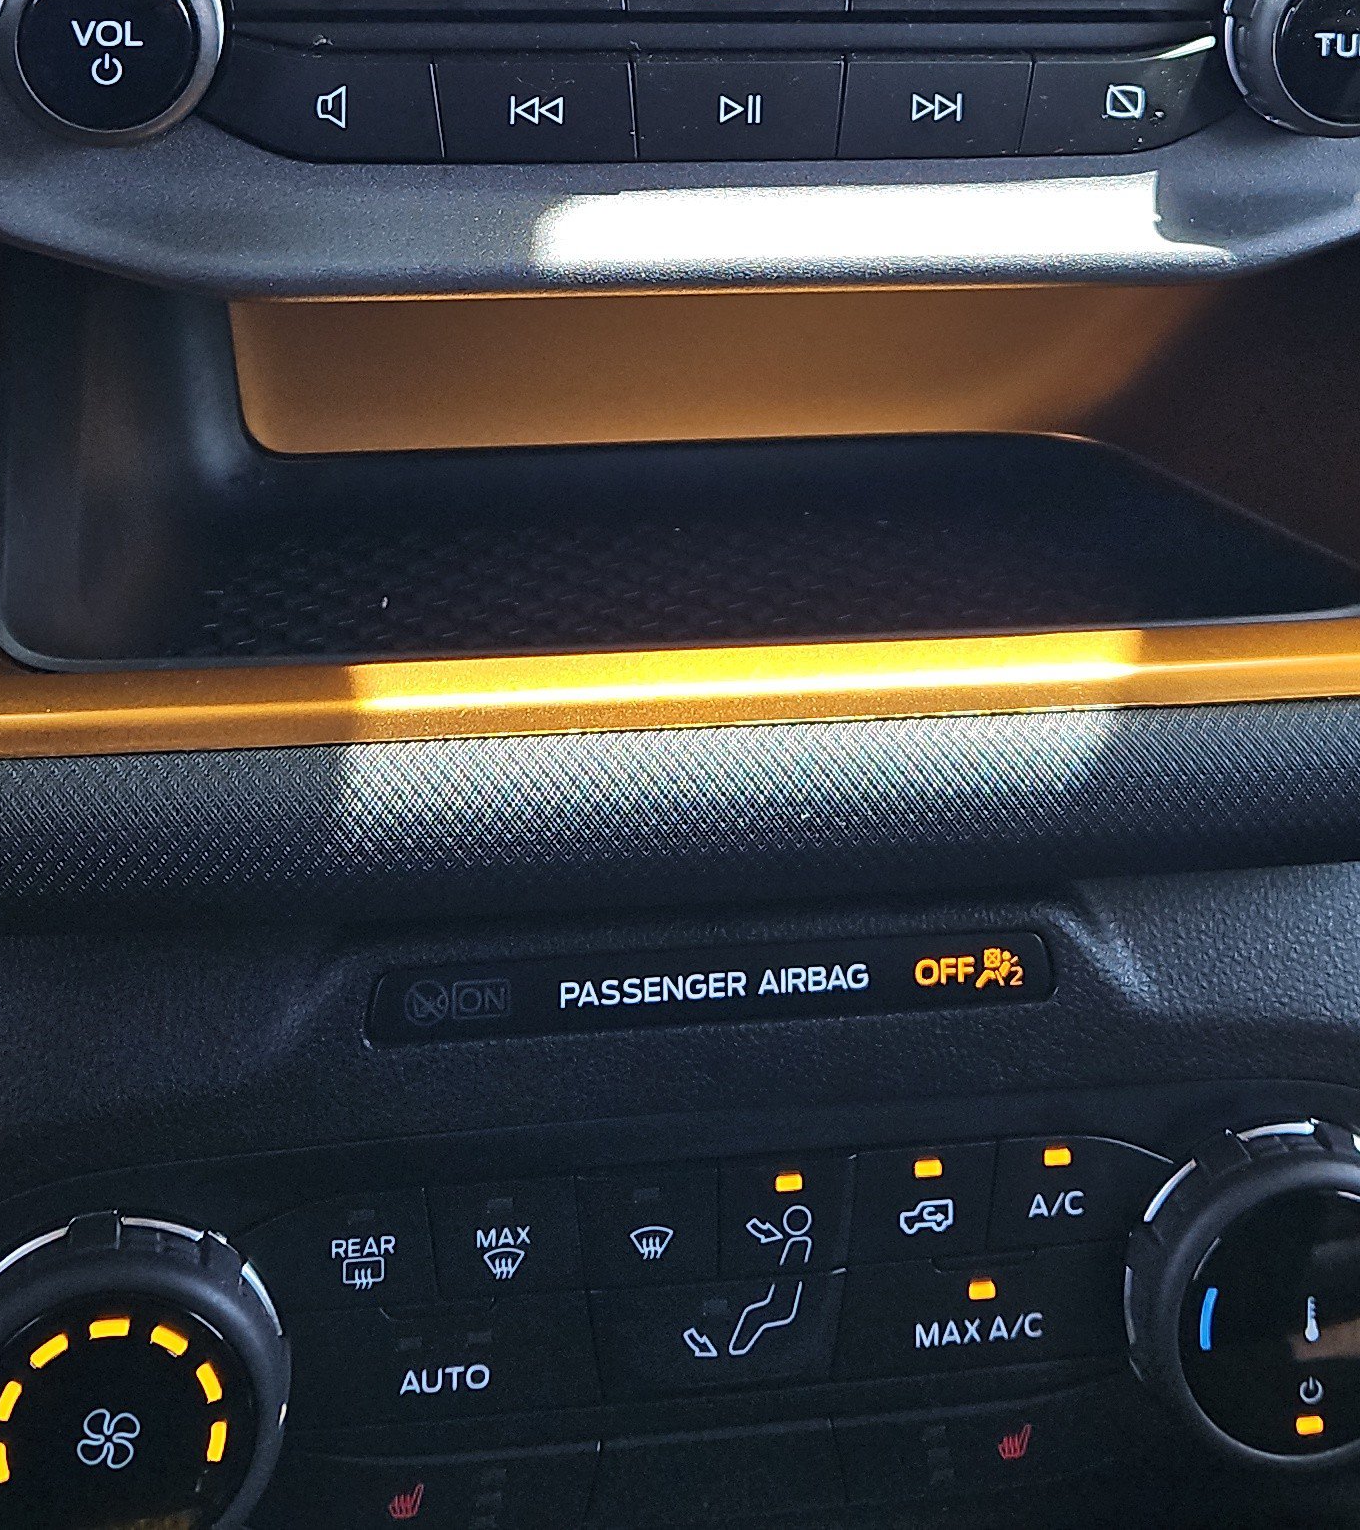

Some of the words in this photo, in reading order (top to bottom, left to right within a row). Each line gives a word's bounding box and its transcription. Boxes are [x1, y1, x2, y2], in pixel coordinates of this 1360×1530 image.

[71, 20, 144, 47] VOL
[914, 956, 975, 986] OFF
[560, 971, 747, 1009] PASSENGER
[757, 963, 869, 995] AIRBAG
[1028, 1190, 1084, 1218] A/C
[331, 1235, 396, 1258] REAR
[476, 1225, 531, 1247] MAX
[915, 1322, 981, 1349] MAX
[988, 1312, 1043, 1341] A/C
[399, 1364, 490, 1395] AUTO
